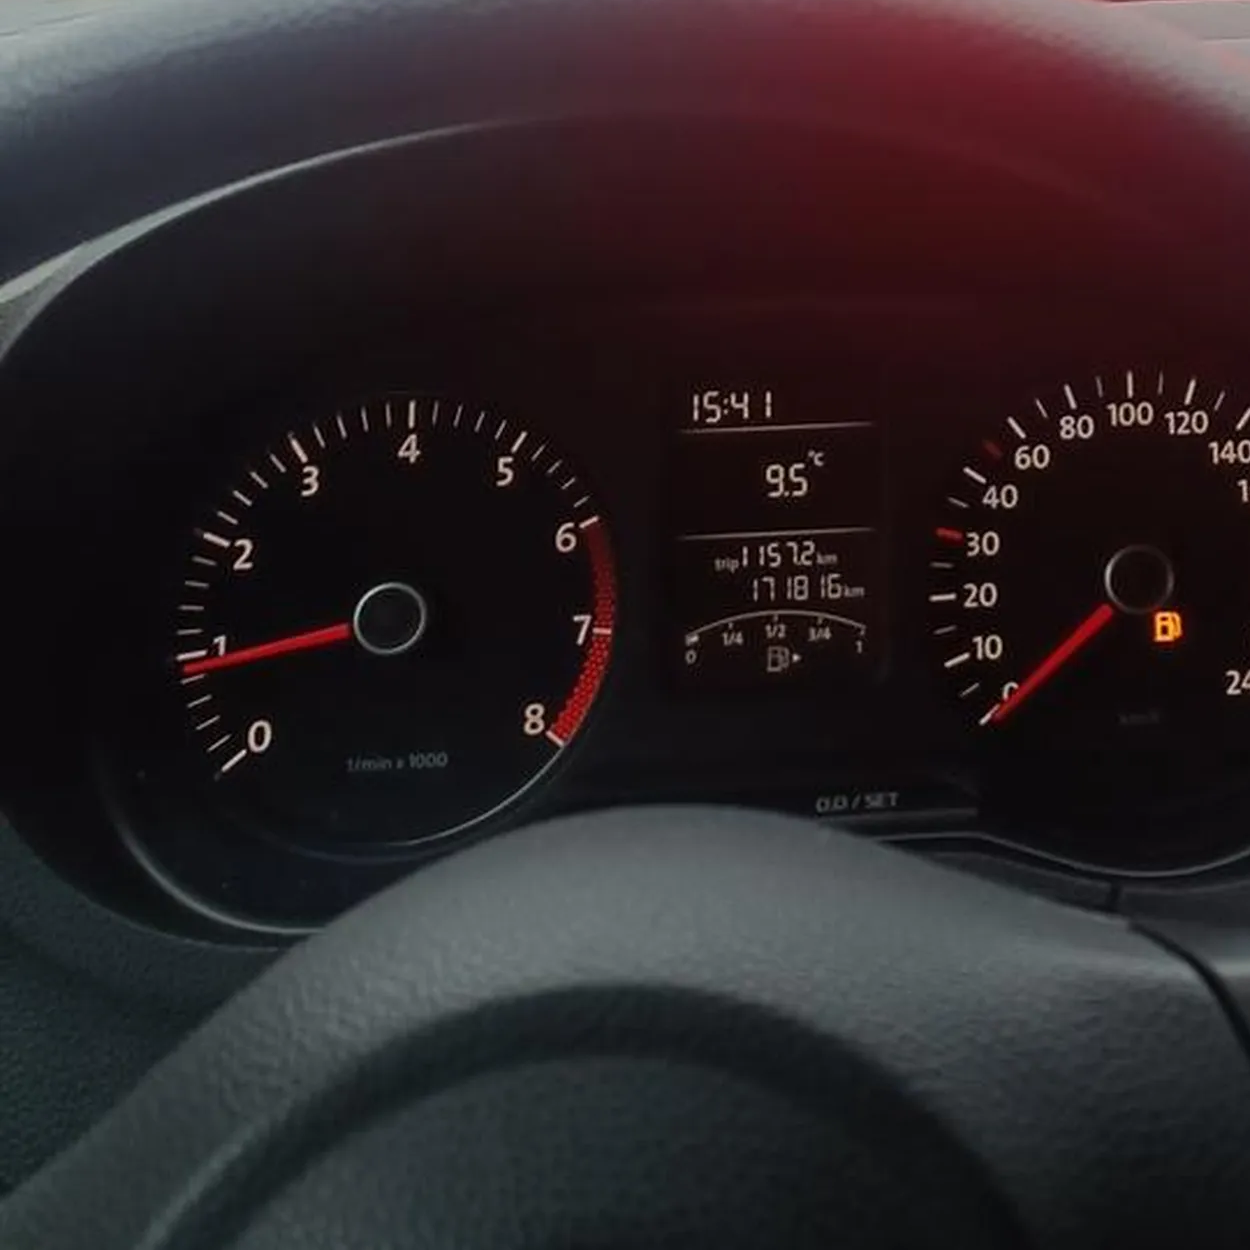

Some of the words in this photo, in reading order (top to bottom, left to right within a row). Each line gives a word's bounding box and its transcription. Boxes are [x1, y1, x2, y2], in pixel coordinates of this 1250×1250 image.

[692, 391, 773, 423] 15:41
[1107, 402, 1153, 426] 100
[1060, 415, 1094, 439] 80
[1165, 410, 1209, 435] 120
[398, 434, 421, 463] 4
[1014, 444, 1051, 470] 60
[301, 466, 321, 497] 3
[496, 456, 514, 487] 5
[766, 464, 809, 498] 9.5
[982, 484, 1018, 509] 40
[555, 522, 577, 552] 6
[966, 531, 1000, 556] 30
[233, 538, 255, 570] 2
[816, 553, 838, 565] km
[752, 573, 842, 602] 171816
[844, 586, 866, 598] km
[963, 582, 998, 608] 20
[573, 615, 592, 646] 7
[722, 631, 744, 647] 1/4
[212, 635, 228, 657] 1
[972, 635, 1003, 660] 10
[523, 703, 546, 735] 8
[247, 720, 273, 752] 0
[408, 751, 449, 768] 1000
